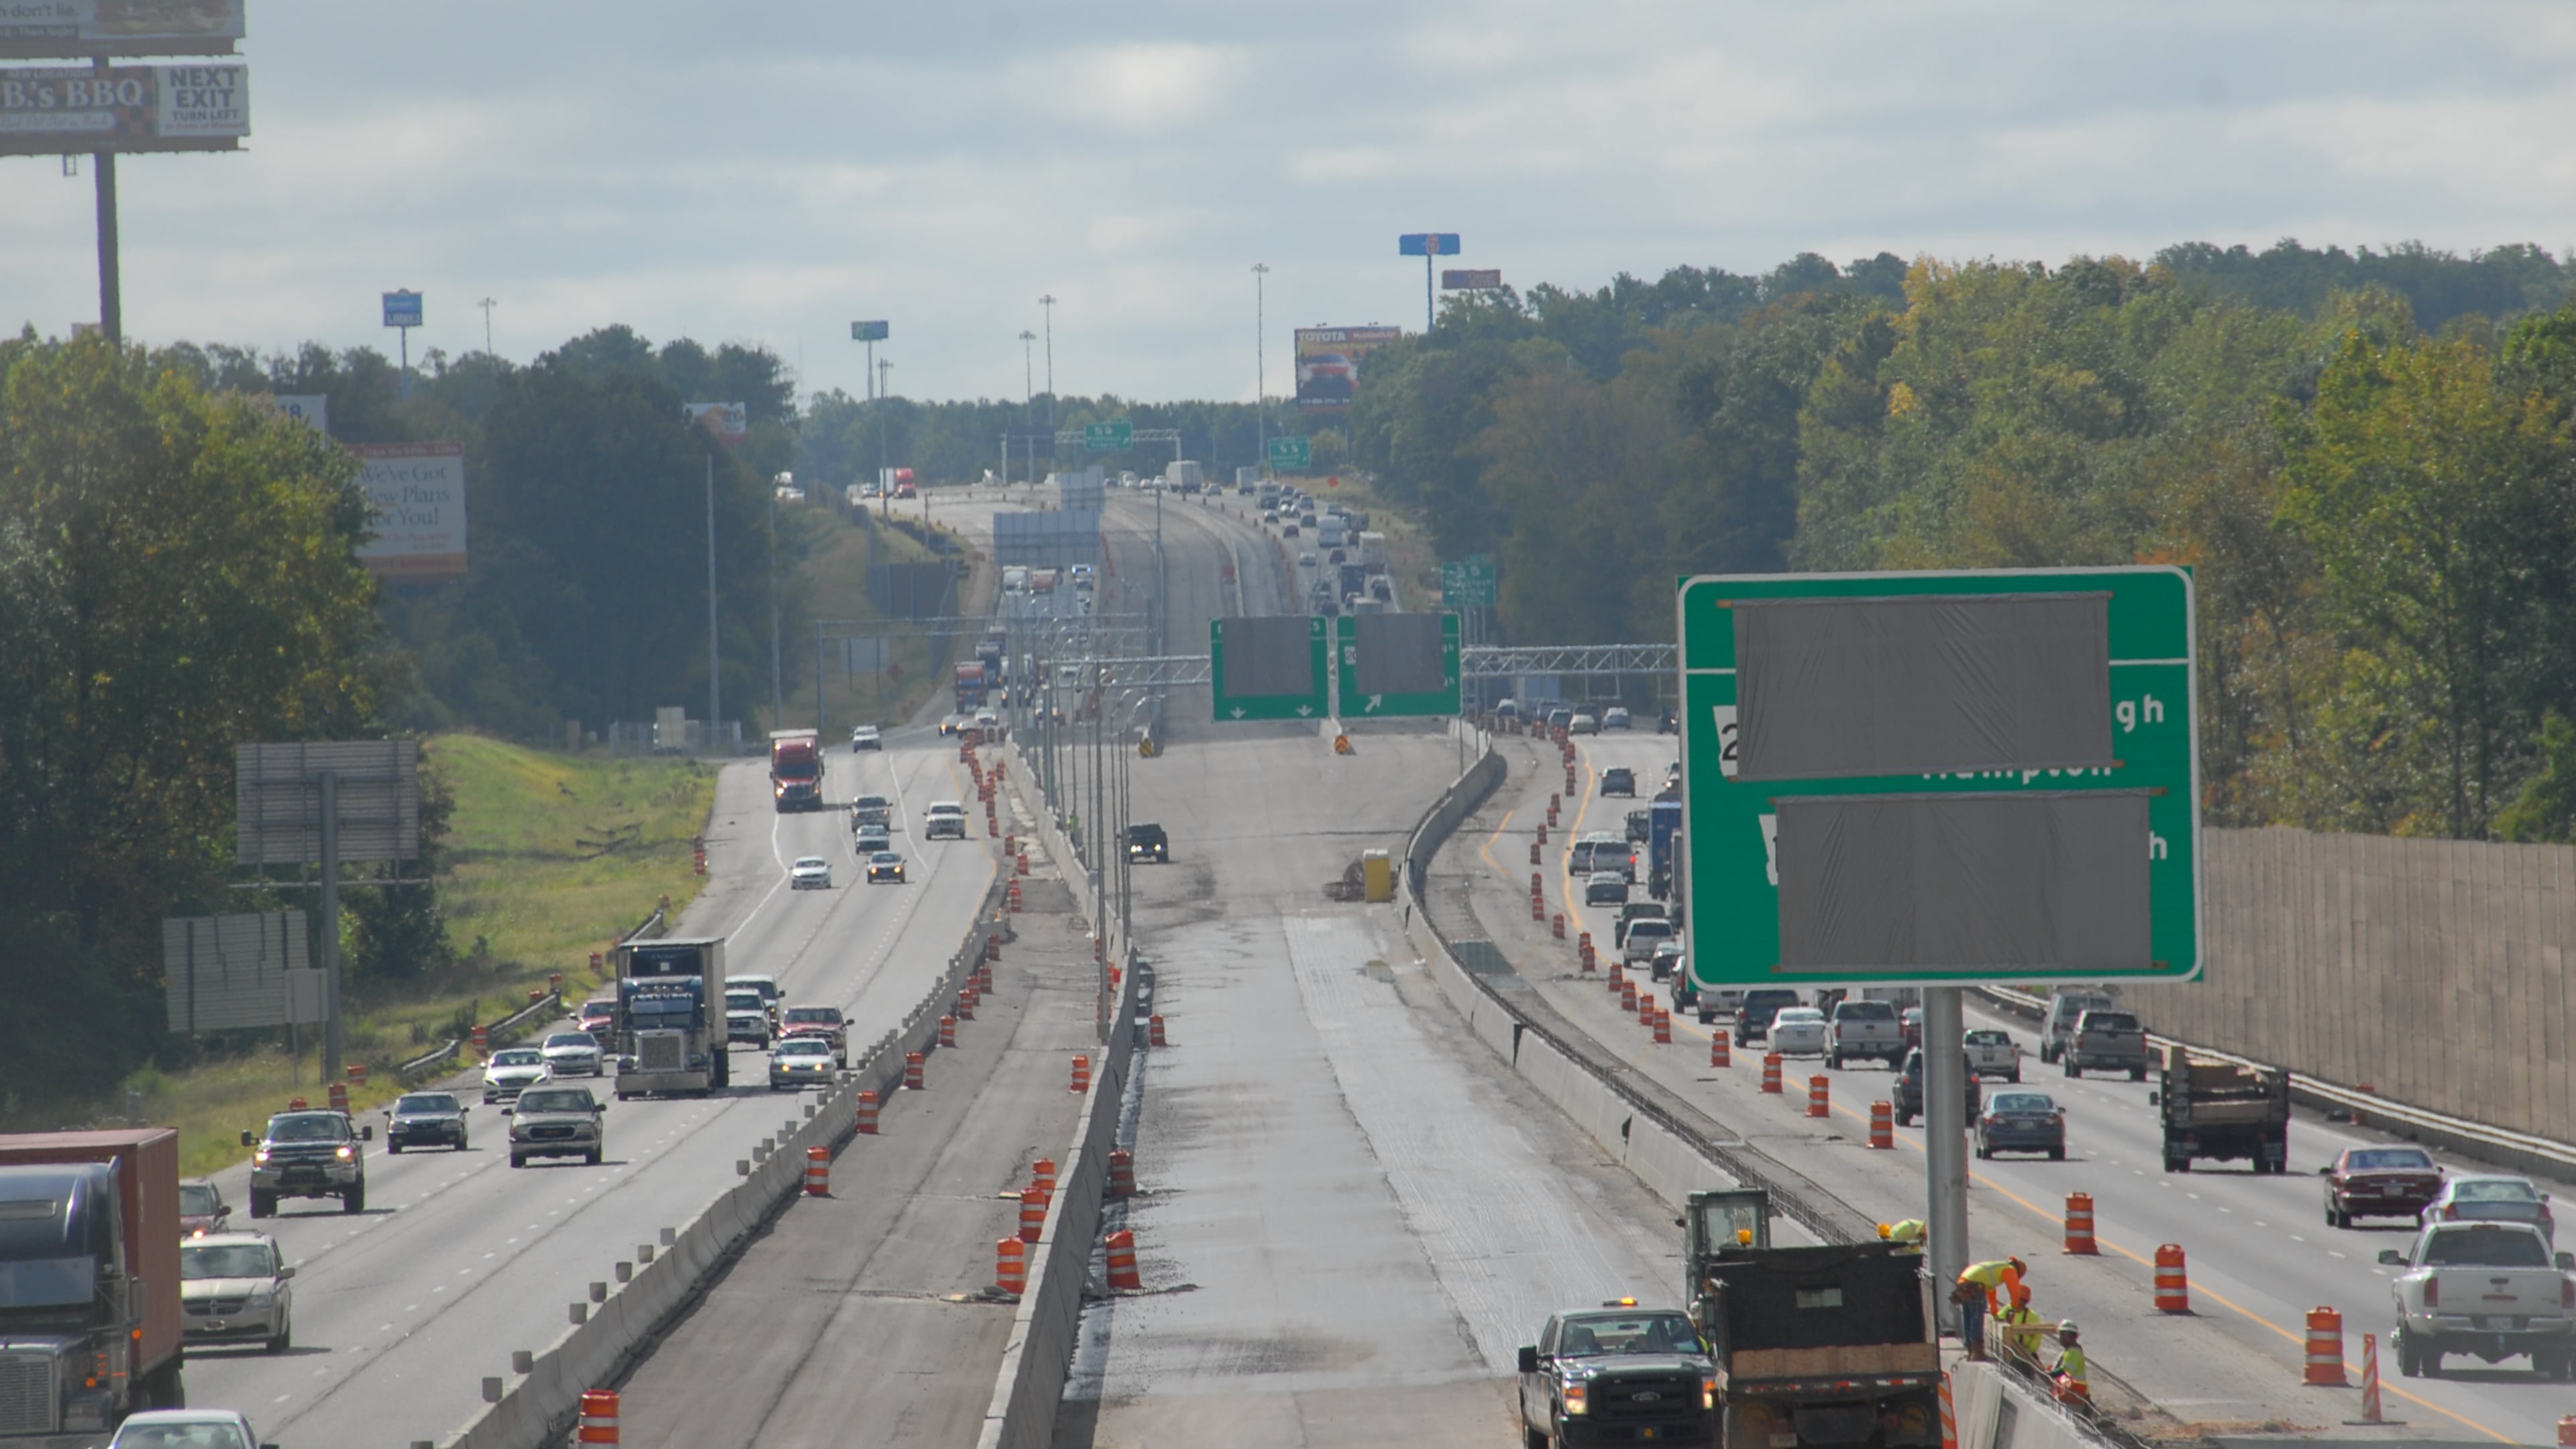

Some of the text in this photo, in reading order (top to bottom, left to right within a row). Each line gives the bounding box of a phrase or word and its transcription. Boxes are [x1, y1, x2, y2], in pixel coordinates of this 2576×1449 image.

[11, 3, 52, 17] don't
[170, 67, 239, 87] NEXT
[66, 78, 144, 108] BBQ
[176, 89, 234, 107] EXIT
[172, 109, 239, 121] TURN LEFT
[1297, 331, 1346, 342] TOYOTA
[413, 464, 446, 482] Got
[403, 485, 450, 503] Plans
[398, 506, 439, 526] You!
